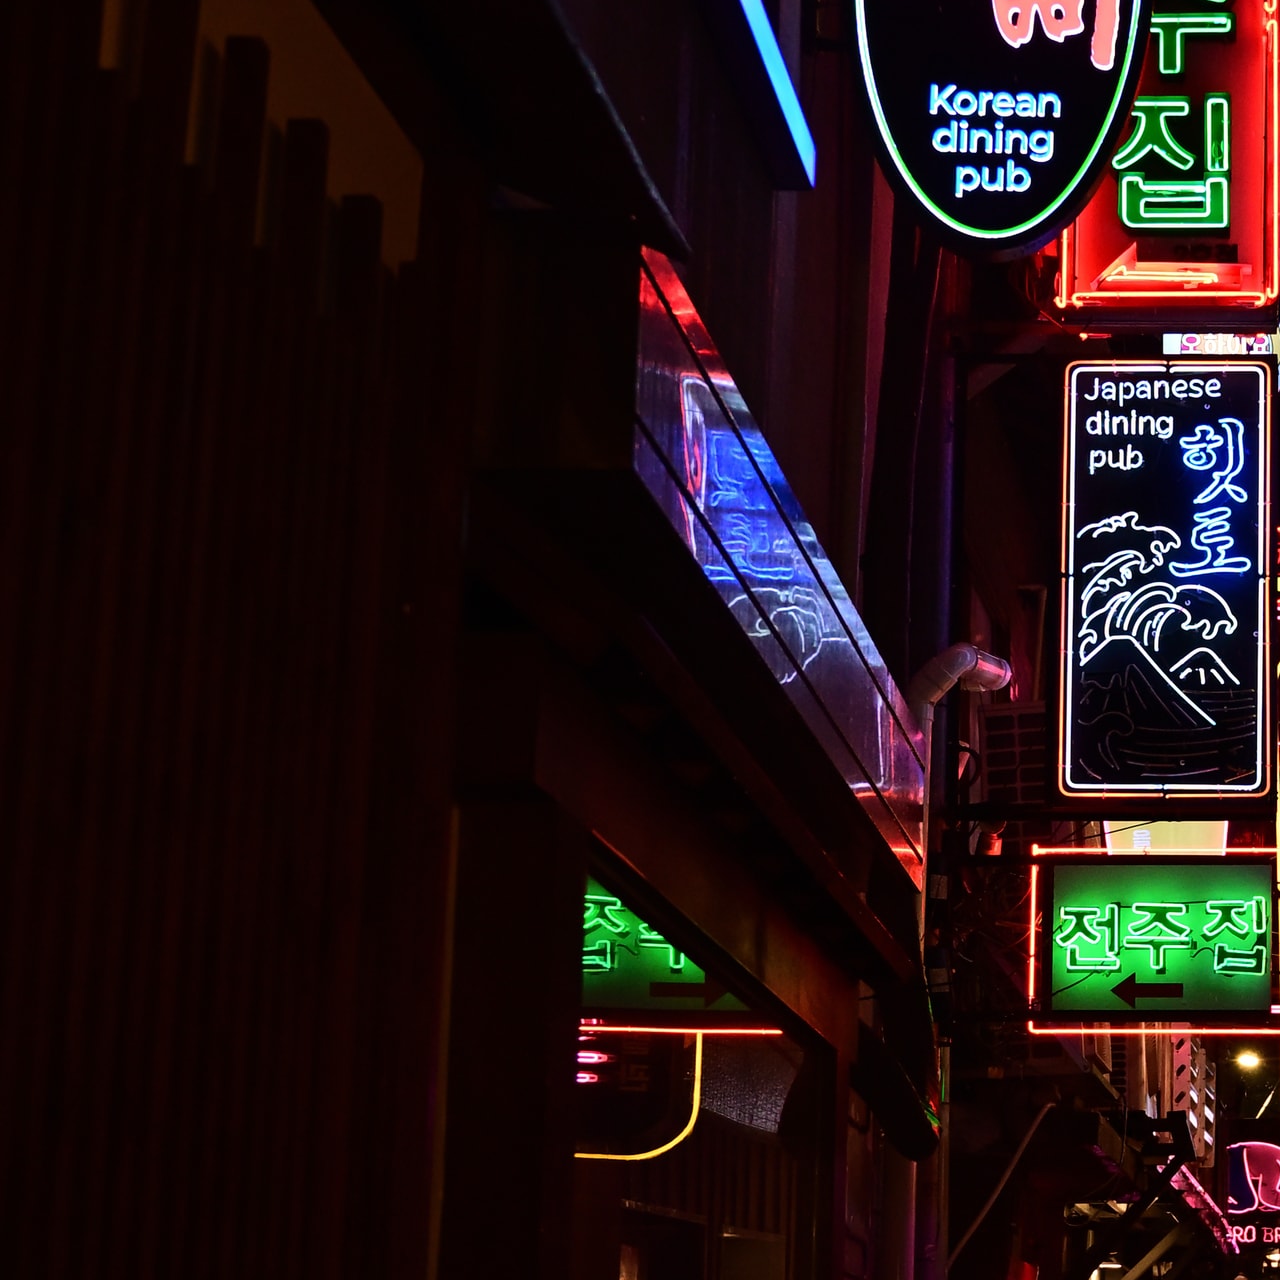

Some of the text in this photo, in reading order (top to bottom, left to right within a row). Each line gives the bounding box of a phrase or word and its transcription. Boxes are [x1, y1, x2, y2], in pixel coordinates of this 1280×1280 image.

[929, 83, 1061, 118] Korean
[932, 119, 1054, 163] dining
[955, 158, 1032, 198] pub
[1084, 377, 1222, 407] Japanese
[1085, 409, 1174, 439] dining
[1089, 443, 1144, 475] pub
[1055, 895, 1266, 976] 전주집
